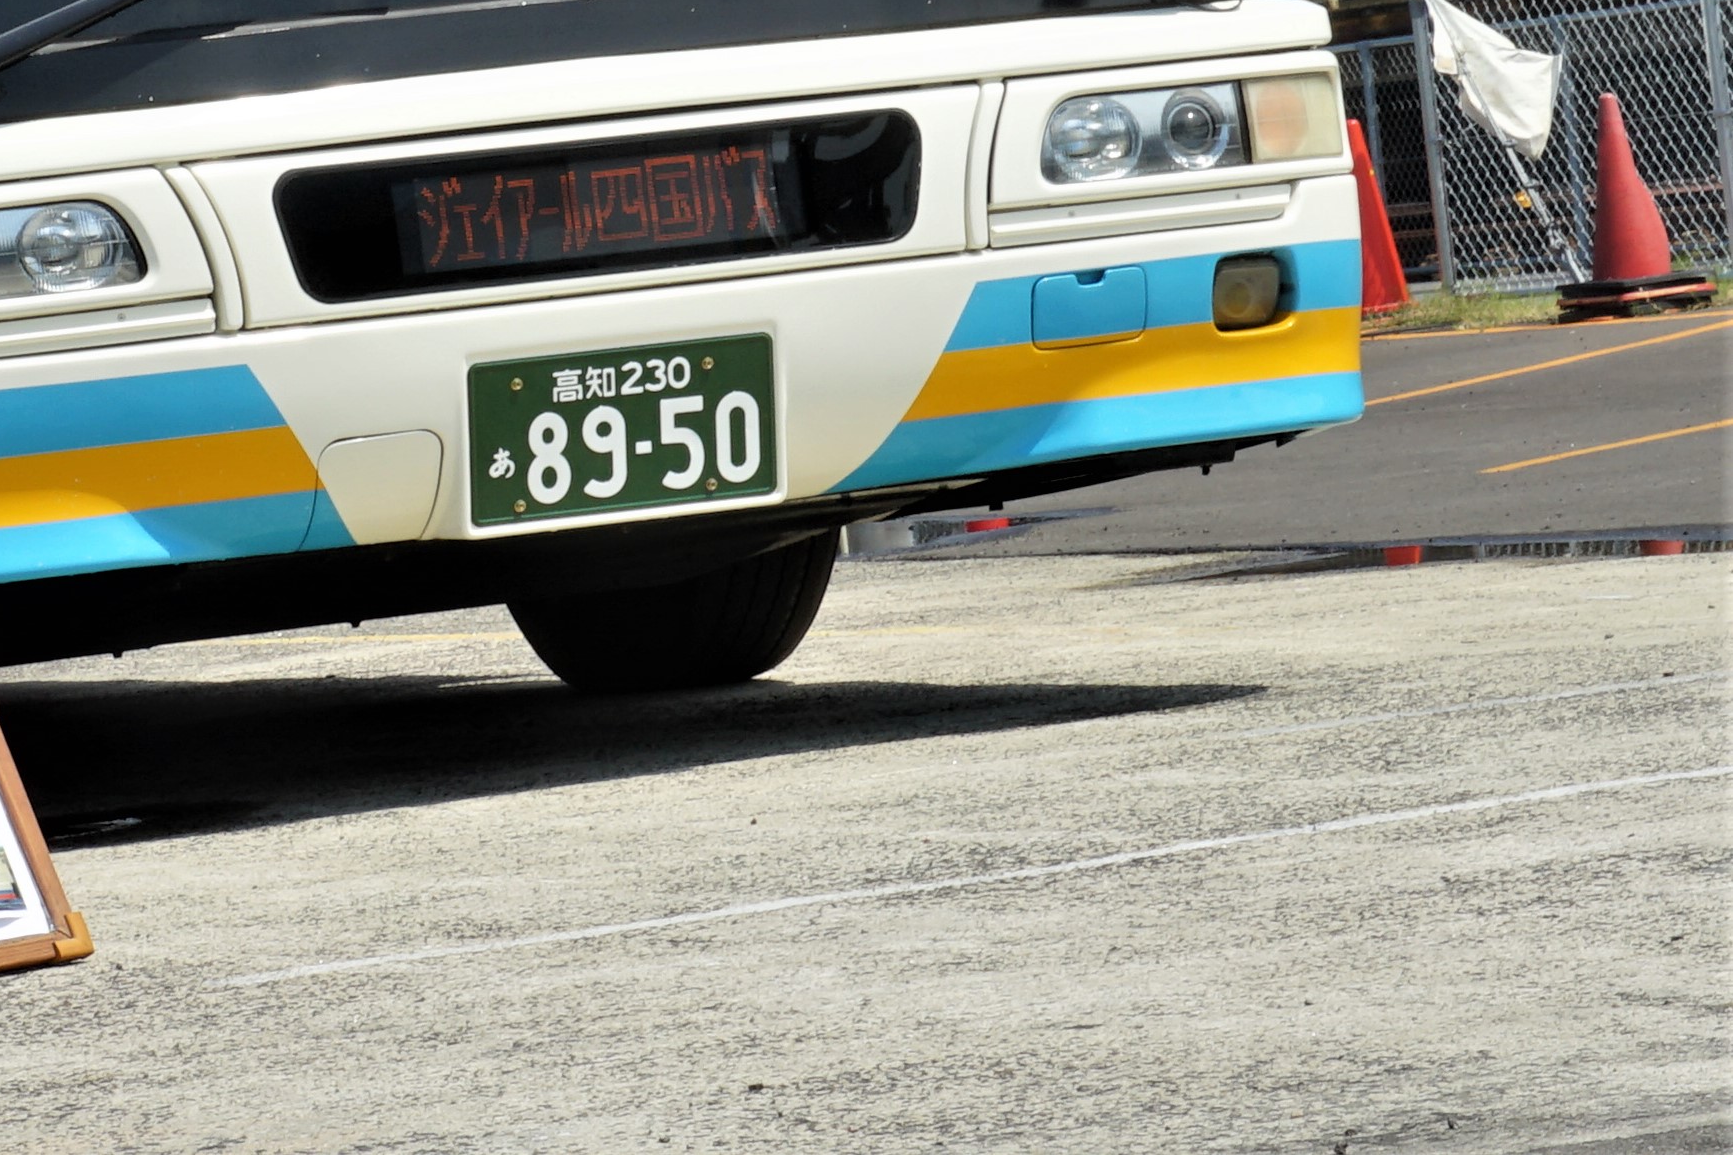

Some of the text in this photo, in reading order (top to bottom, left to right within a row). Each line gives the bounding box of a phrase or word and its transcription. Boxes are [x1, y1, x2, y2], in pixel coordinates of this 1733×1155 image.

[418, 146, 777, 268] ジェイアール四国バス
[488, 390, 761, 505] あ 89-50
